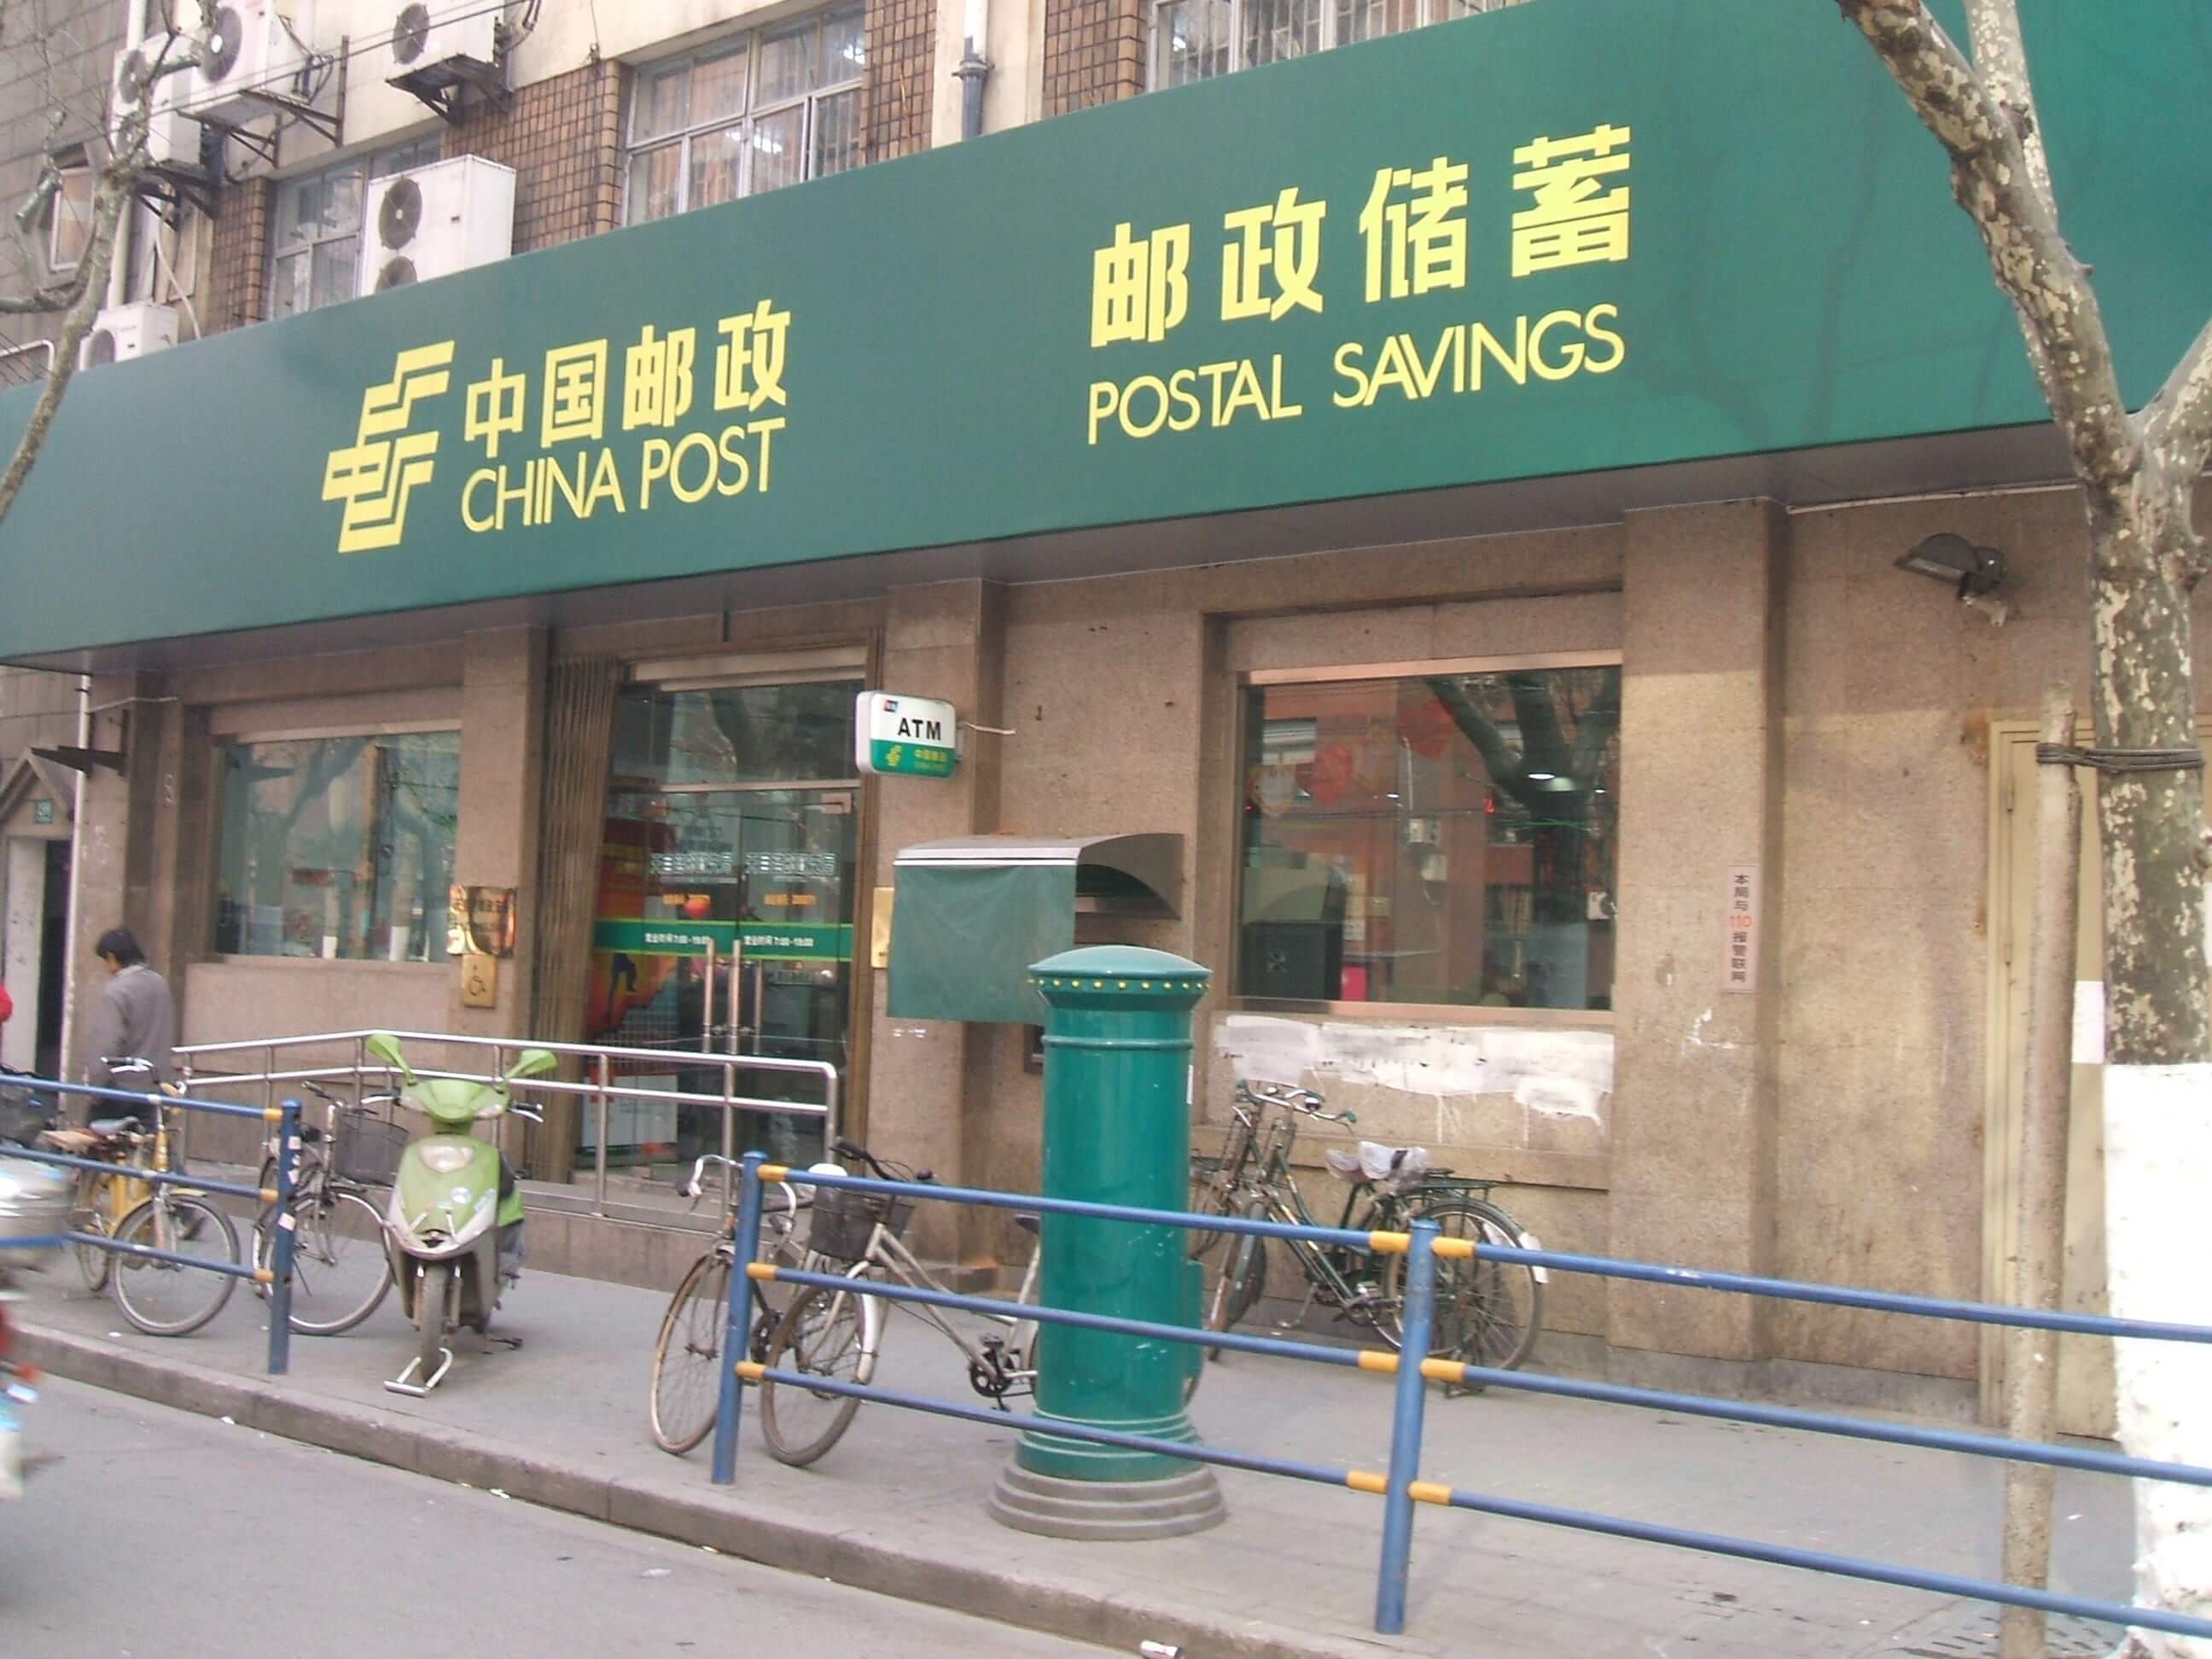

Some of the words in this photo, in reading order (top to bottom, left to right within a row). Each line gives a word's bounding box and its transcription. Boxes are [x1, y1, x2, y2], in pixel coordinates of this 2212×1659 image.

[1091, 124, 1631, 348] 邮政储蓄
[464, 299, 791, 458] 中国邮政
[1088, 354, 1302, 445] POSTAL
[1333, 304, 1625, 408] SAVINGS
[462, 447, 626, 533] CHINA
[640, 416, 786, 509] POST
[898, 718, 941, 740] ATM
